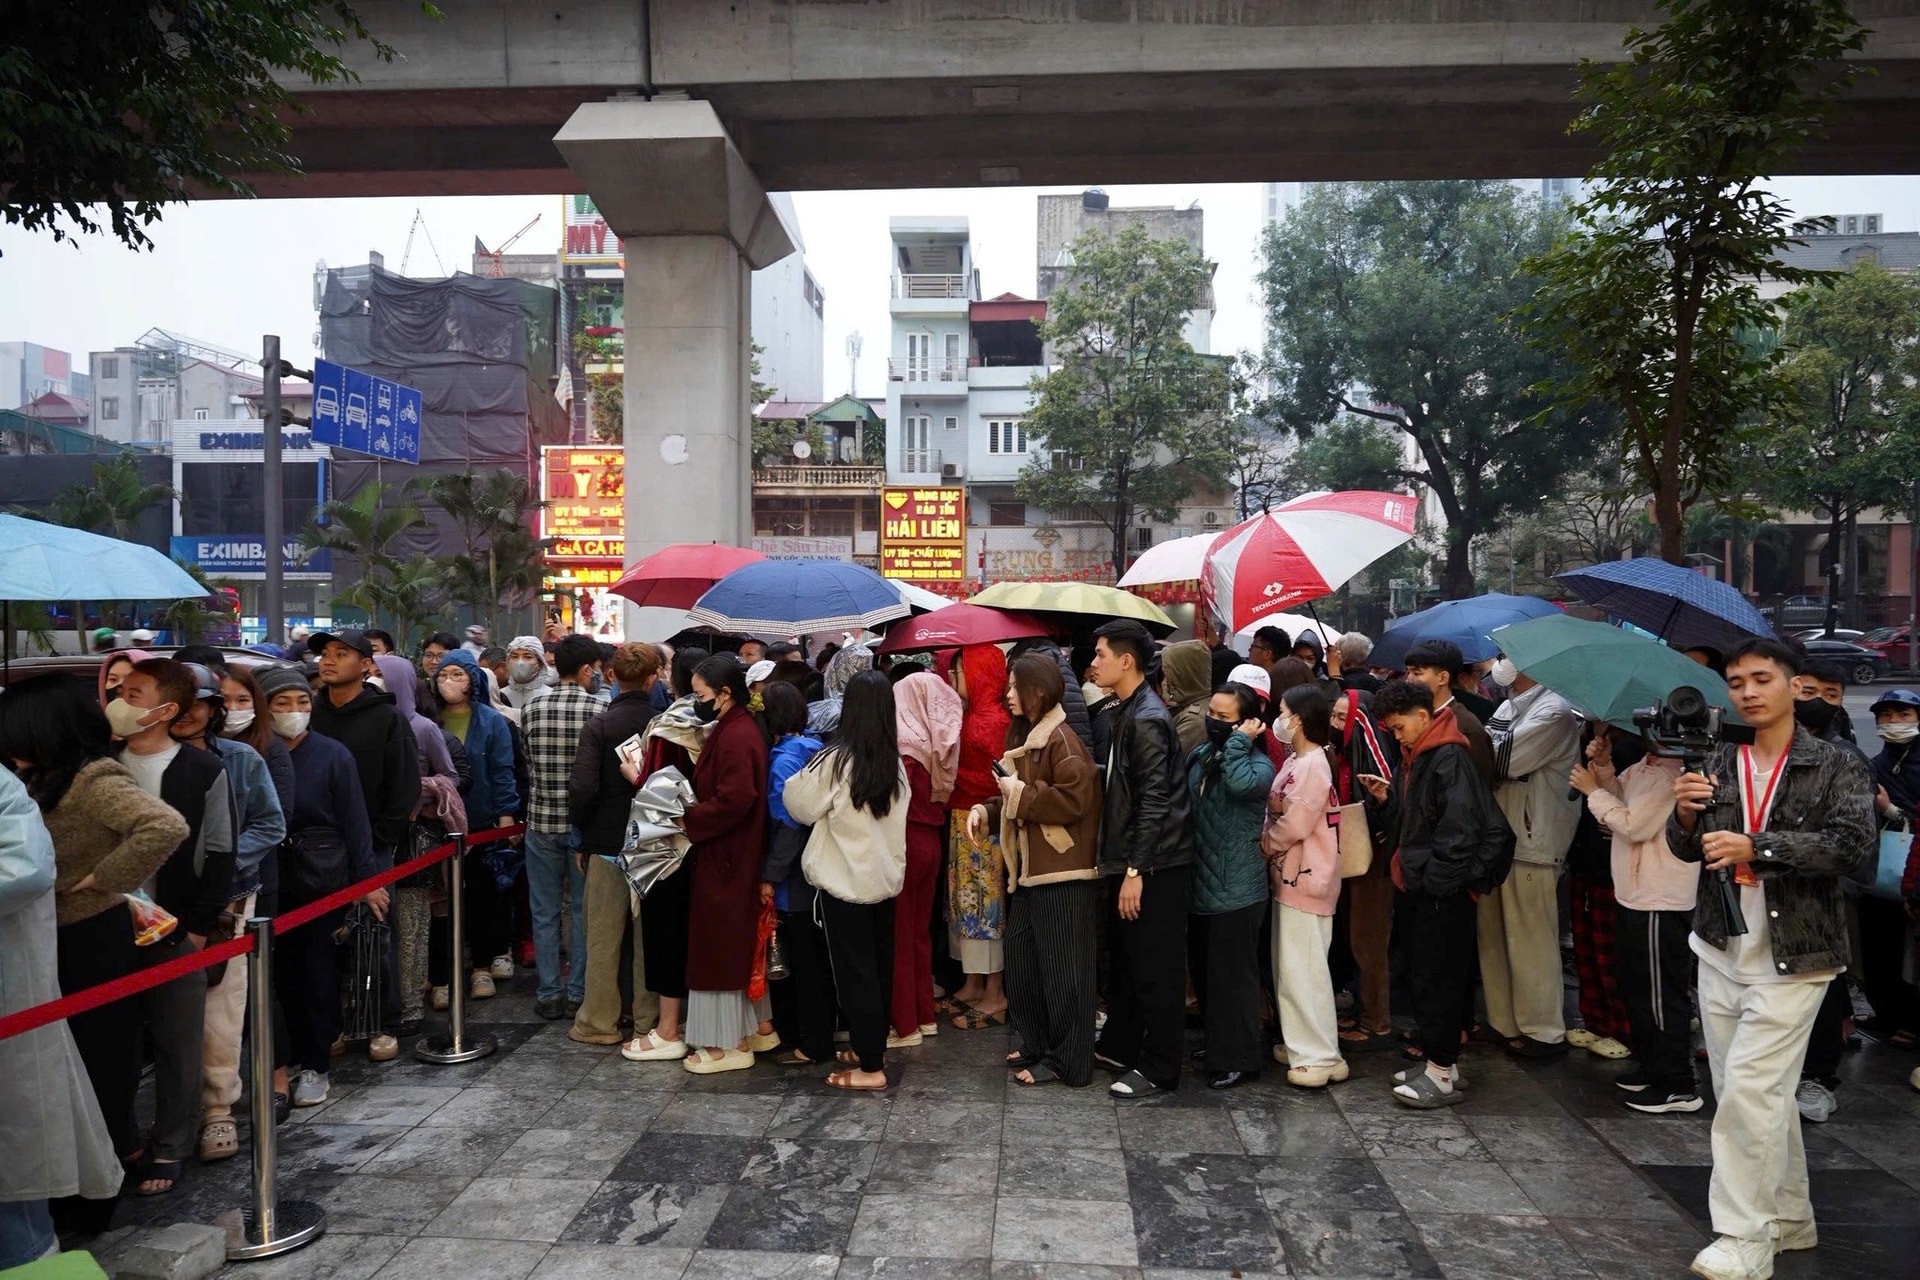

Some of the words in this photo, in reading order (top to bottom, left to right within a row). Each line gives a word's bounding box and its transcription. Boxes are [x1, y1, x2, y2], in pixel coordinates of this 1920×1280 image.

[200, 432, 313, 450] EXIMBNK
[886, 513, 917, 538] HẢI
[921, 516, 960, 538] LIÊN
